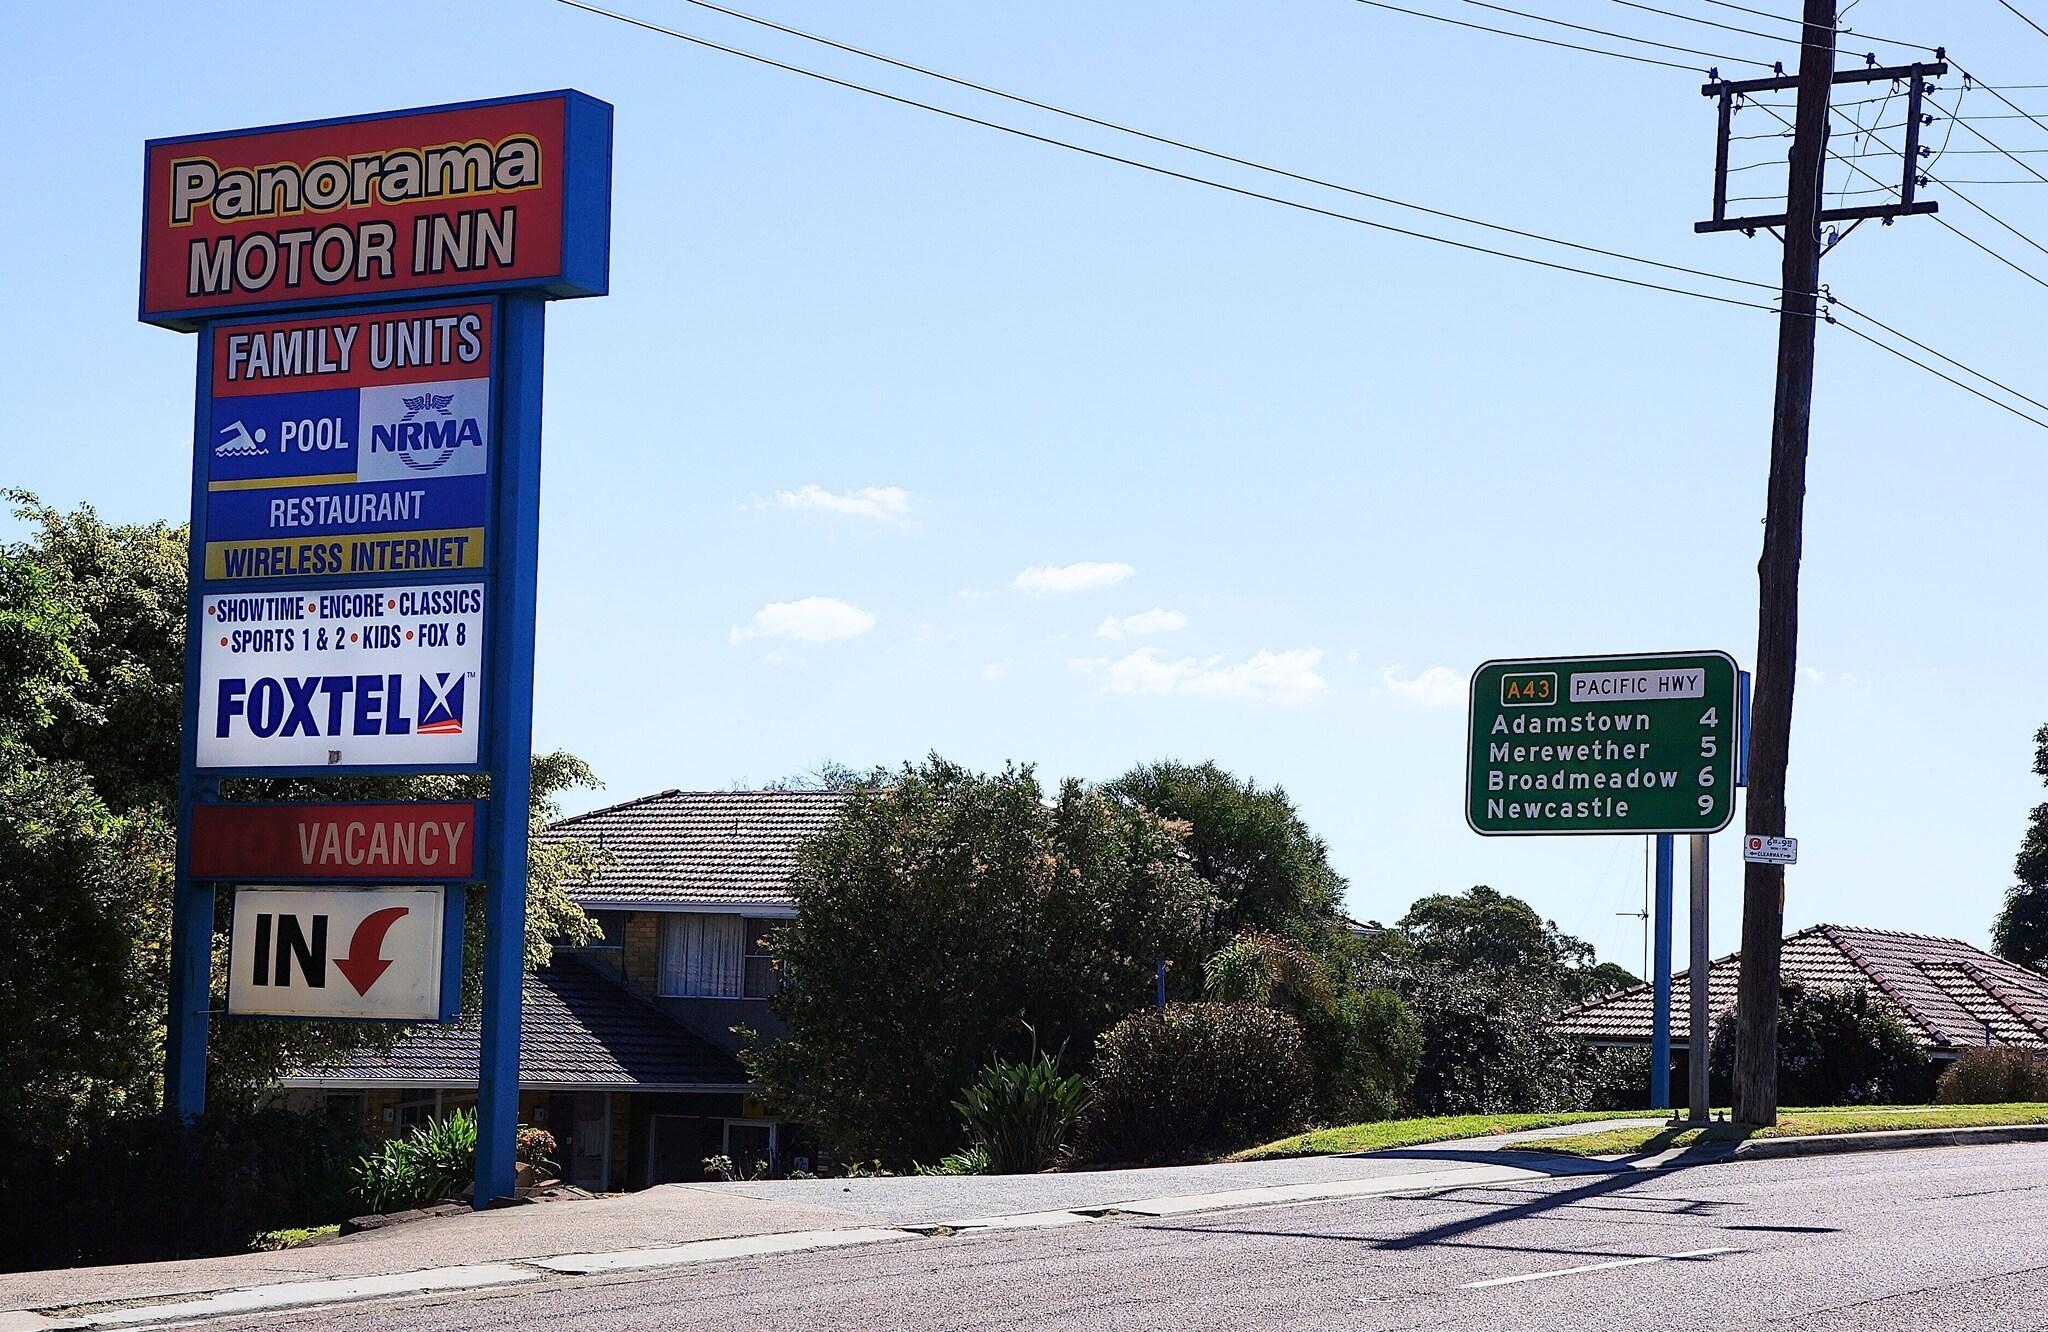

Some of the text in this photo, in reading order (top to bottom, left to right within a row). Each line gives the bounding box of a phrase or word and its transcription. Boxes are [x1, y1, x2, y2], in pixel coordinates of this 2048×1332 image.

[172, 136, 540, 225] Panorama
[187, 207, 516, 296] MOTOR INN
[227, 313, 482, 380] FAMILY UNITS
[280, 417, 349, 453] POOL
[371, 418, 483, 453] NRMA
[269, 491, 425, 528] RESTAURANT
[224, 537, 468, 578] WIRELESS INTERNET
[216, 589, 481, 623] SHOWTIME ENCORE CLASSICS
[231, 622, 466, 653] SPORTS 1 & 2 KIDS FOX 8
[1507, 680, 1550, 699] A43
[1576, 675, 1698, 696] PACIFIC HWY
[216, 674, 411, 738] FOXTEL
[1491, 707, 1718, 735] Adamstown 4
[1489, 736, 1717, 763] Merewether 5
[1488, 765, 1715, 791] Broadmeadow 6
[1487, 795, 1714, 819] Newcastle 9
[298, 821, 466, 865] VACANCY
[252, 913, 329, 988] IN
